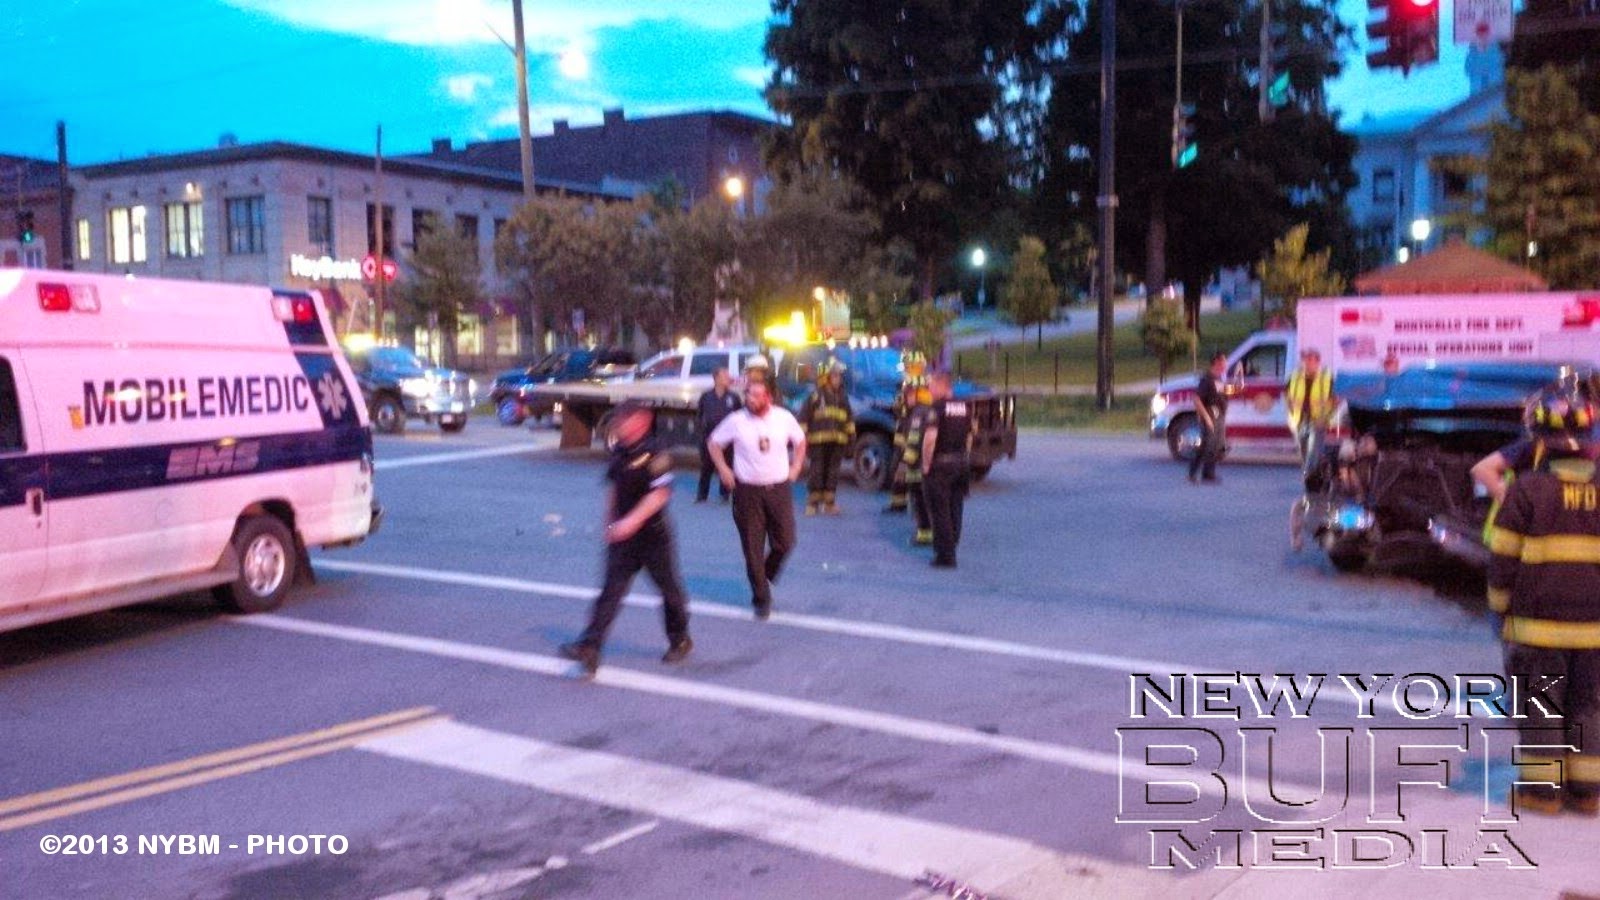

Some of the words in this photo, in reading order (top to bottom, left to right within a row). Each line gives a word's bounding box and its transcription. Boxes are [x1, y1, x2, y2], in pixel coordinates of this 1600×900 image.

[1467, 316, 1490, 332] FIRE
[1435, 339, 1503, 355] OPERATIONS
[1508, 338, 1534, 353] UNIT
[83, 374, 309, 426] MOBILEMEDIC
[165, 440, 261, 480] EMS
[1563, 482, 1596, 511] MFD
